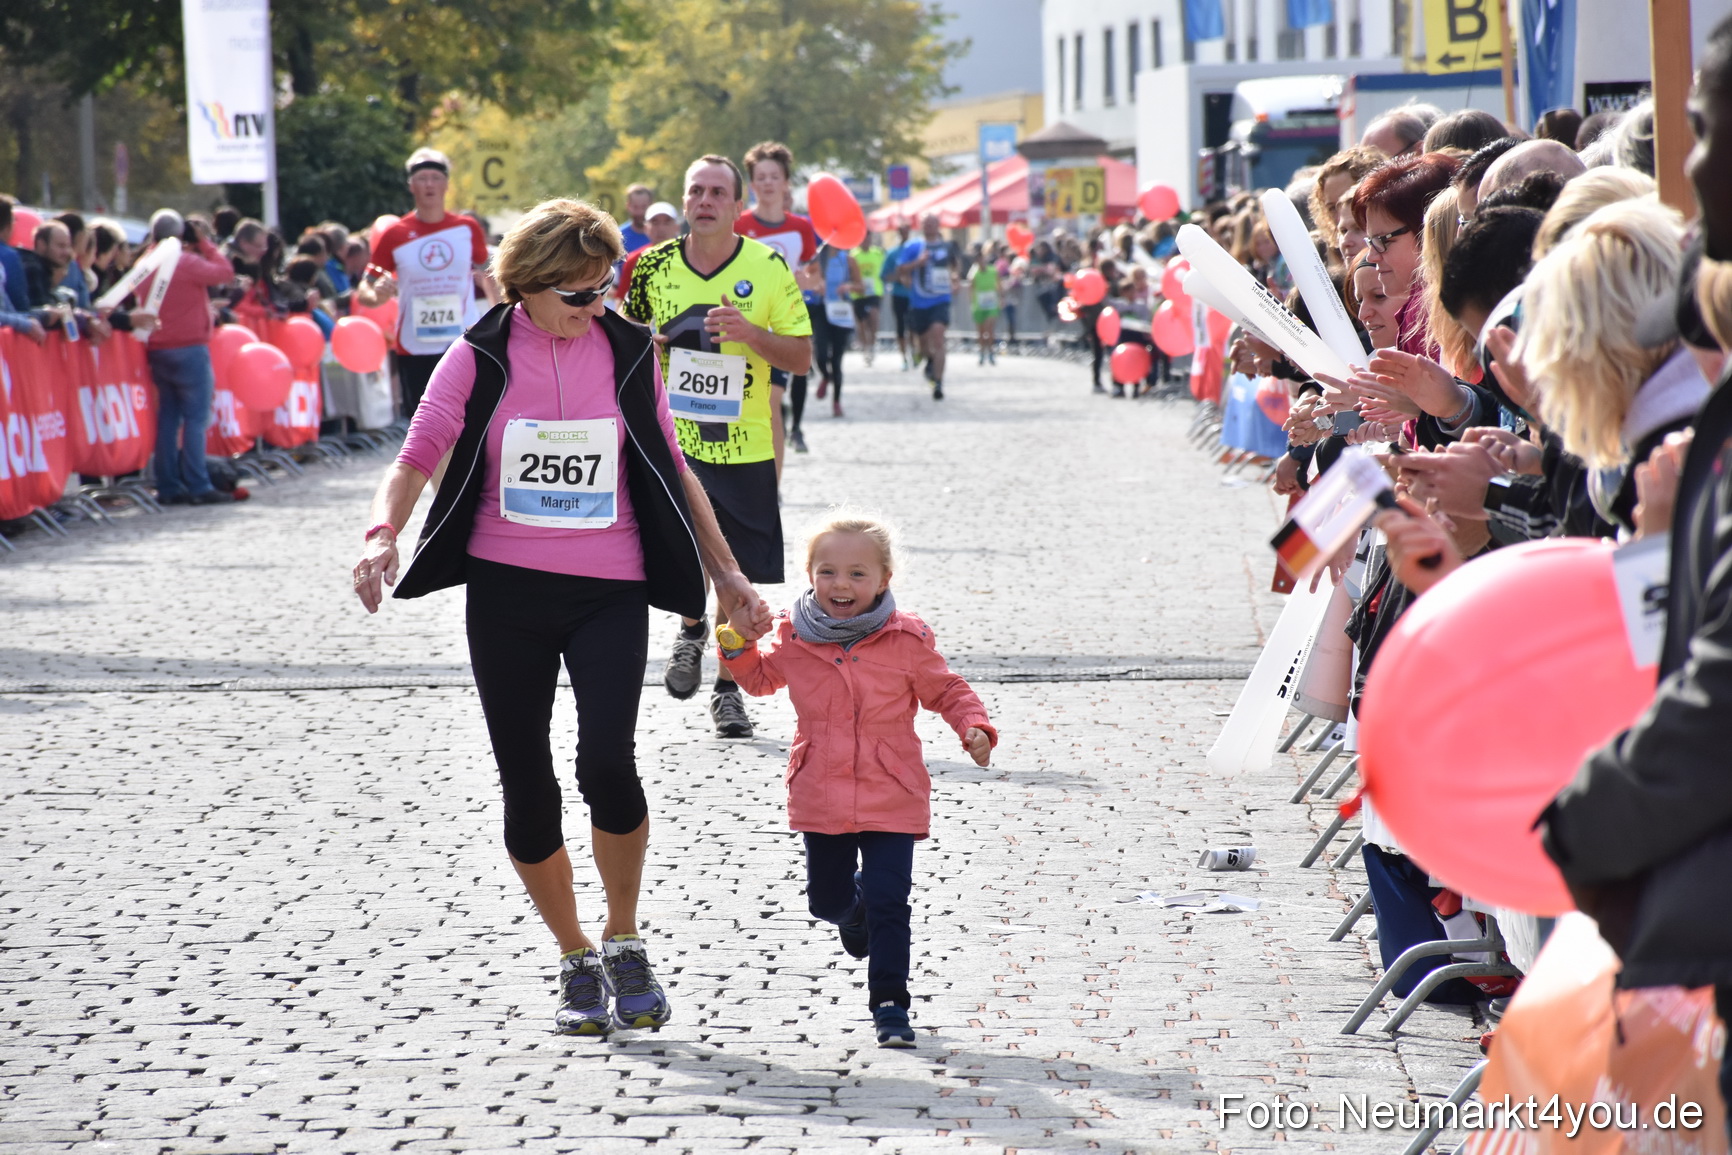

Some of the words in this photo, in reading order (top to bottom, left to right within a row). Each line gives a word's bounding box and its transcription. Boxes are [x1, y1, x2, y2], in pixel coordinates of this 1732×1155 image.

[1446, 0, 1488, 42] B
[482, 156, 506, 190] C
[1083, 180, 1100, 205] D
[420, 310, 455, 325] 2474
[1251, 286, 1278, 312] stadtwerke
[1278, 310, 1303, 335] neumarkt
[1258, 301, 1266, 309] wir
[1264, 307, 1279, 321] bieten
[678, 371, 729, 395] 2691
[690, 400, 717, 411] Franco
[549, 431, 589, 440] BOCK
[519, 453, 602, 486] 2567
[540, 496, 580, 511] Margit
[1286, 666, 1301, 699] stadtwerke
[1299, 634, 1313, 664] neumarkt
[616, 944, 633, 953] 2567
